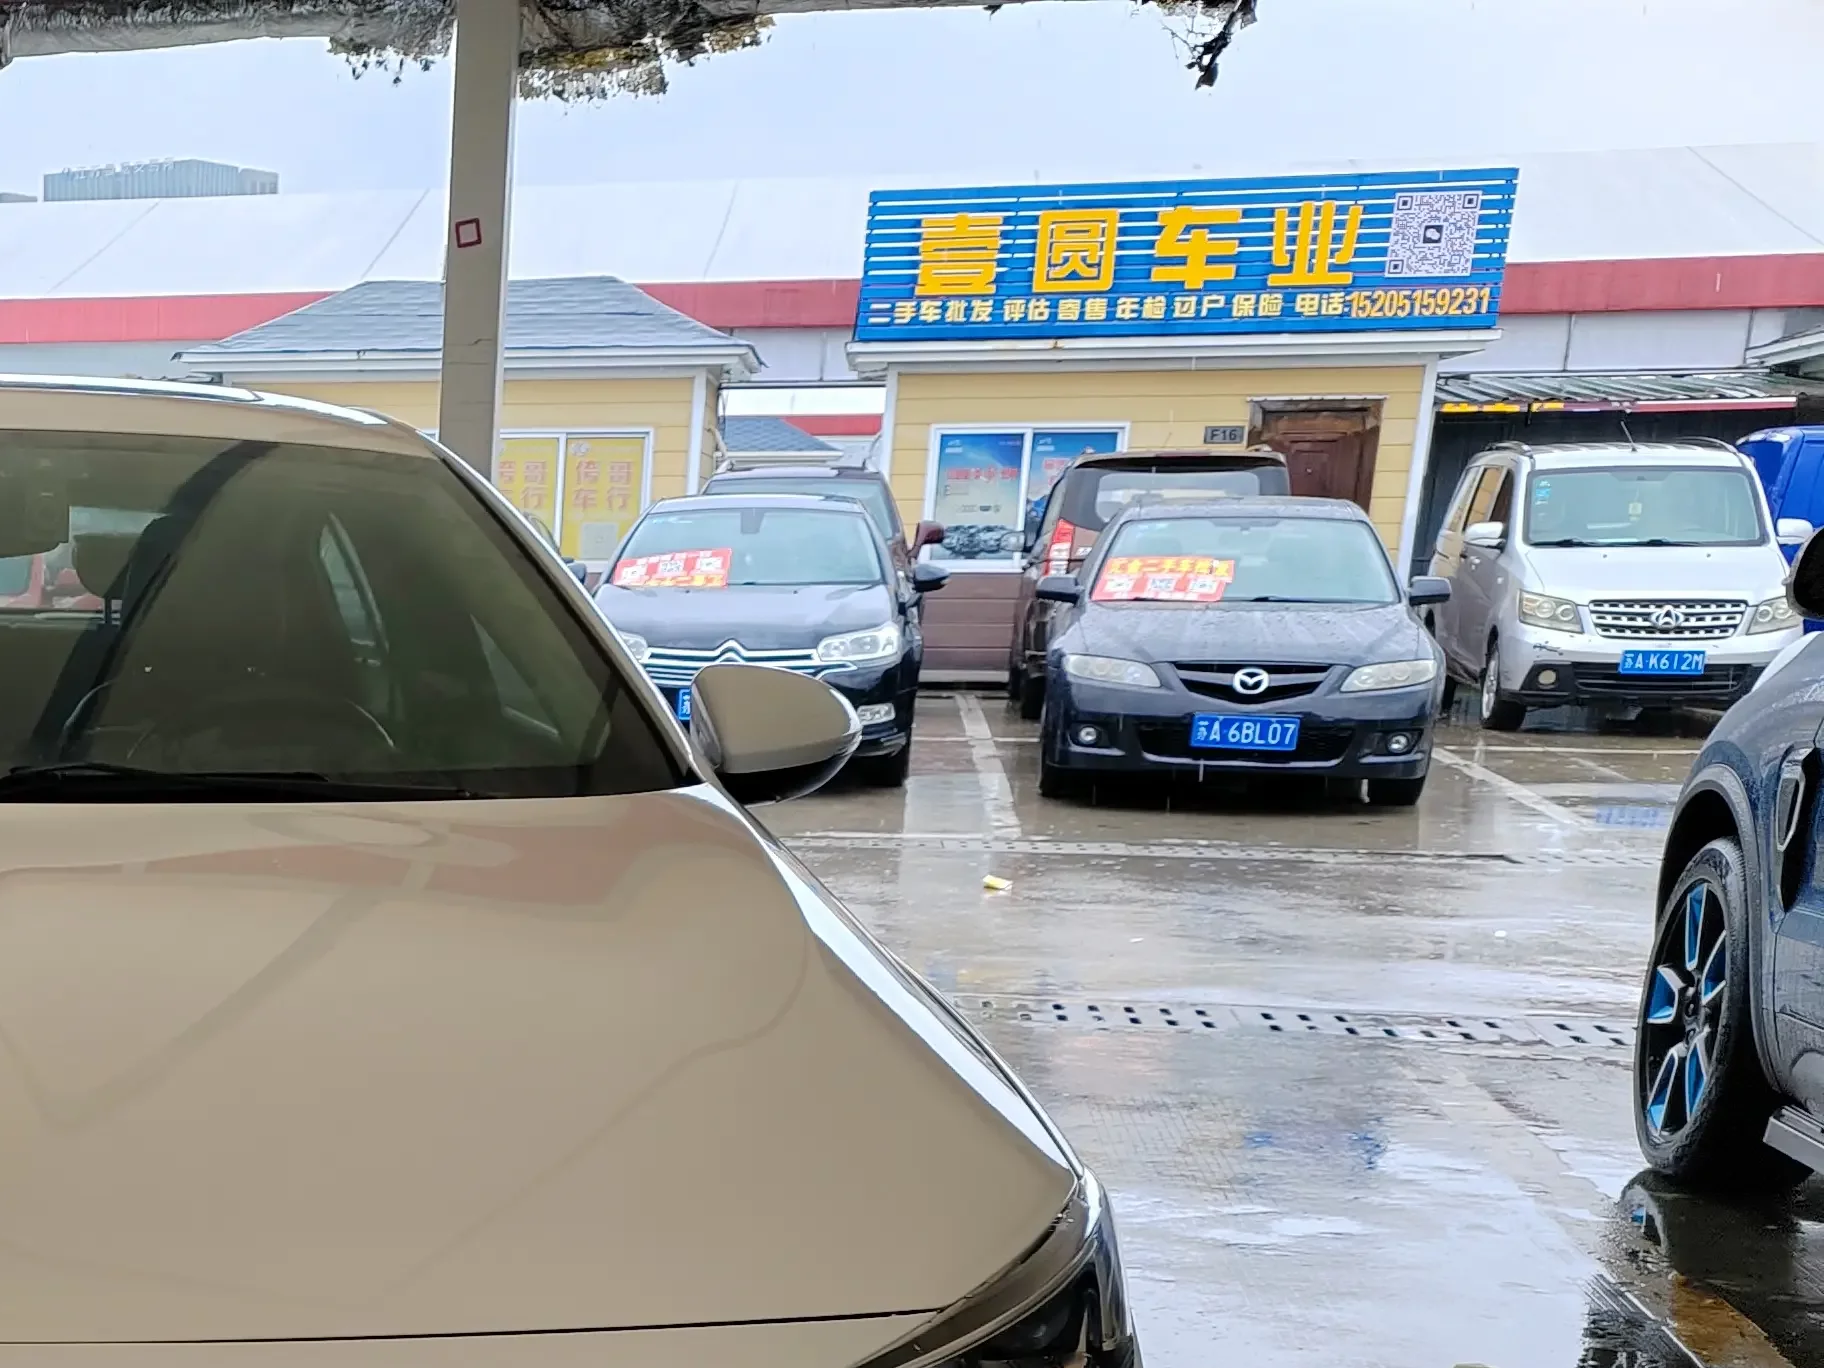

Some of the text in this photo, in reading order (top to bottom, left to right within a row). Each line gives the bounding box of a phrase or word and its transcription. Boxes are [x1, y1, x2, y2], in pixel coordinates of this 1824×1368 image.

[915, 200, 1363, 297] 壹圆车业
[868, 299, 994, 324] 二手车批发
[1003, 299, 1051, 322] 评估
[1057, 298, 1108, 321] 寄售
[1115, 296, 1167, 320] 年检
[1173, 294, 1225, 317] 过户
[1232, 293, 1282, 318] 保险
[1211, 429, 1237, 441] F16
[573, 487, 632, 511] 车行
